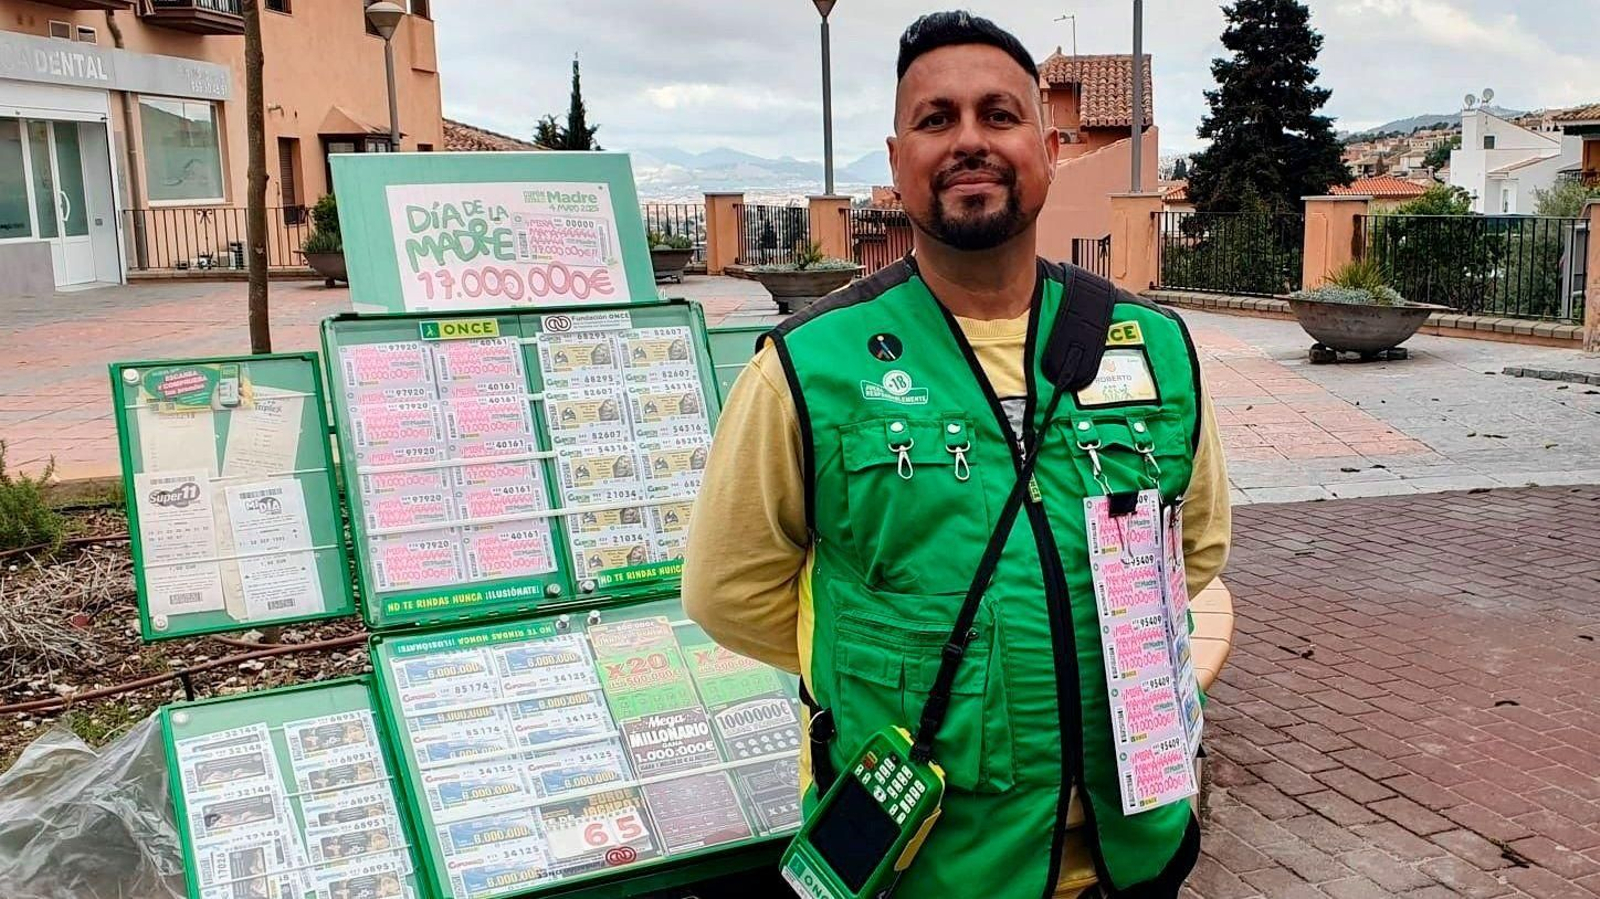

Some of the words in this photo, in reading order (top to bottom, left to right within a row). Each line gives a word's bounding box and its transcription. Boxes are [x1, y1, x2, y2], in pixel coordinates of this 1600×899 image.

[35, 50, 108, 80] DENTAL
[546, 191, 598, 204] Madre
[406, 201, 465, 233] DÍA
[462, 199, 485, 216] DE
[489, 205, 509, 222] LA
[565, 219, 594, 228] 00000
[406, 218, 516, 273] MADRE
[417, 261, 615, 302] 17.000.000€
[444, 321, 494, 335] ONCE
[389, 343, 418, 352] 97920
[480, 338, 508, 347] 40161
[584, 375, 614, 383] 68295
[661, 369, 690, 378] 82607
[396, 388, 425, 397] 97920
[488, 382, 516, 391] 40161
[584, 387, 613, 396] 82607
[489, 395, 517, 404] 40161
[399, 402, 428, 410] 97920
[592, 430, 621, 439] 82607
[673, 424, 701, 433] 54316
[496, 440, 525, 449] 40161
[406, 447, 436, 456] 97920
[503, 485, 532, 494] 40161
[606, 490, 637, 499] 21034
[511, 530, 540, 540] 40161
[612, 534, 643, 542] 21034
[420, 540, 449, 550] 97920
[600, 575, 612, 584] NO
[614, 573, 624, 582] TE
[627, 569, 657, 580] RINDAS
[387, 602, 401, 612] NO
[402, 601, 414, 610] TE
[416, 596, 450, 609] RINDAS
[452, 592, 483, 605] NUNCA
[1140, 615, 1162, 628] 95409
[491, 628, 525, 641] RINDAS
[528, 627, 538, 636] TE
[539, 625, 551, 634] NO
[458, 633, 488, 646] NUNCA
[528, 653, 579, 668] 6.000.000
[554, 672, 587, 684] 34125
[1150, 676, 1170, 689] 95409
[455, 682, 489, 695] 85174
[566, 712, 599, 723] 34125
[648, 714, 687, 728] Mega
[466, 725, 500, 737] 85174
[629, 721, 709, 748] MILLONARIO
[1160, 738, 1180, 752] 95409
[579, 750, 613, 763] 34125
[635, 740, 715, 763] 1.000.000€
[340, 752, 372, 764] 68951
[479, 764, 514, 776] 34125
[565, 771, 616, 788] 6.000.000
[462, 784, 516, 800] 6.000.000
[350, 793, 383, 805] 68951
[354, 818, 386, 830] 68951
[474, 826, 530, 844] 6.000.000
[503, 846, 540, 860] 34125
[363, 862, 396, 874] 68951
